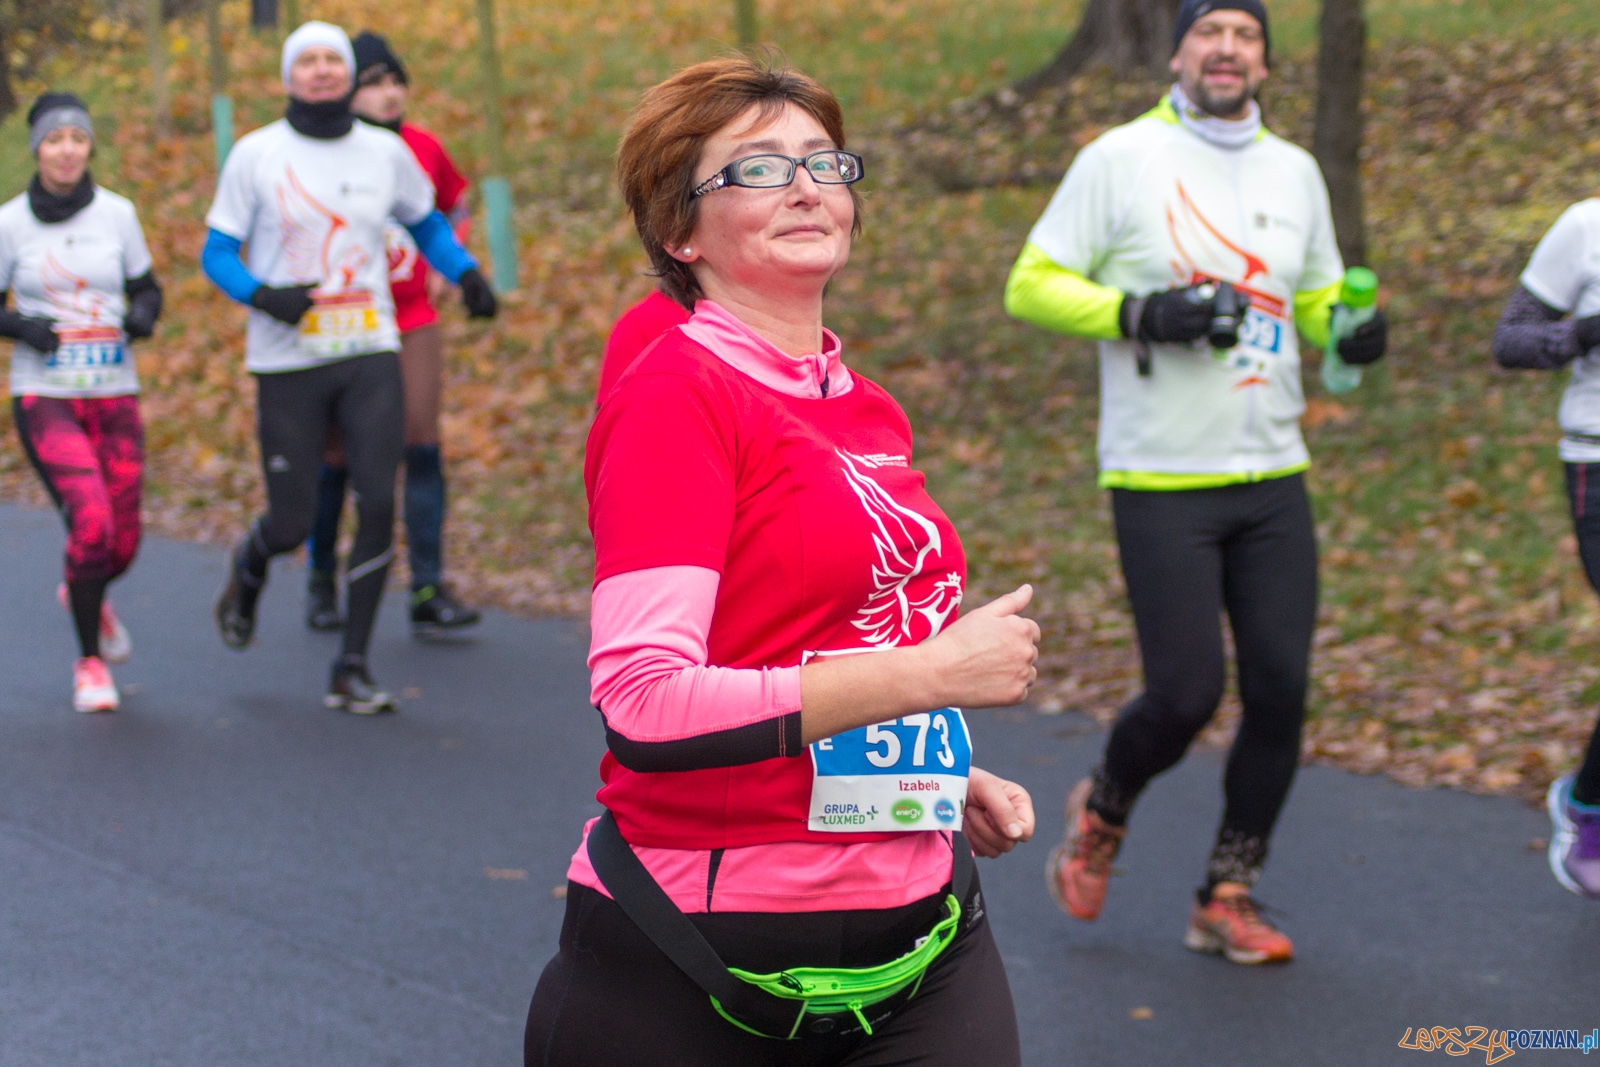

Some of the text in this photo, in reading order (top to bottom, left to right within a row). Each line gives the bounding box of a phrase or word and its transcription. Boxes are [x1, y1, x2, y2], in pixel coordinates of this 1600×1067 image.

[865, 713, 955, 769] 573
[899, 780, 940, 792] Izabela
[824, 804, 860, 814] GRUPA
[895, 808, 921, 819] energy
[823, 815, 866, 825] LUXMED
